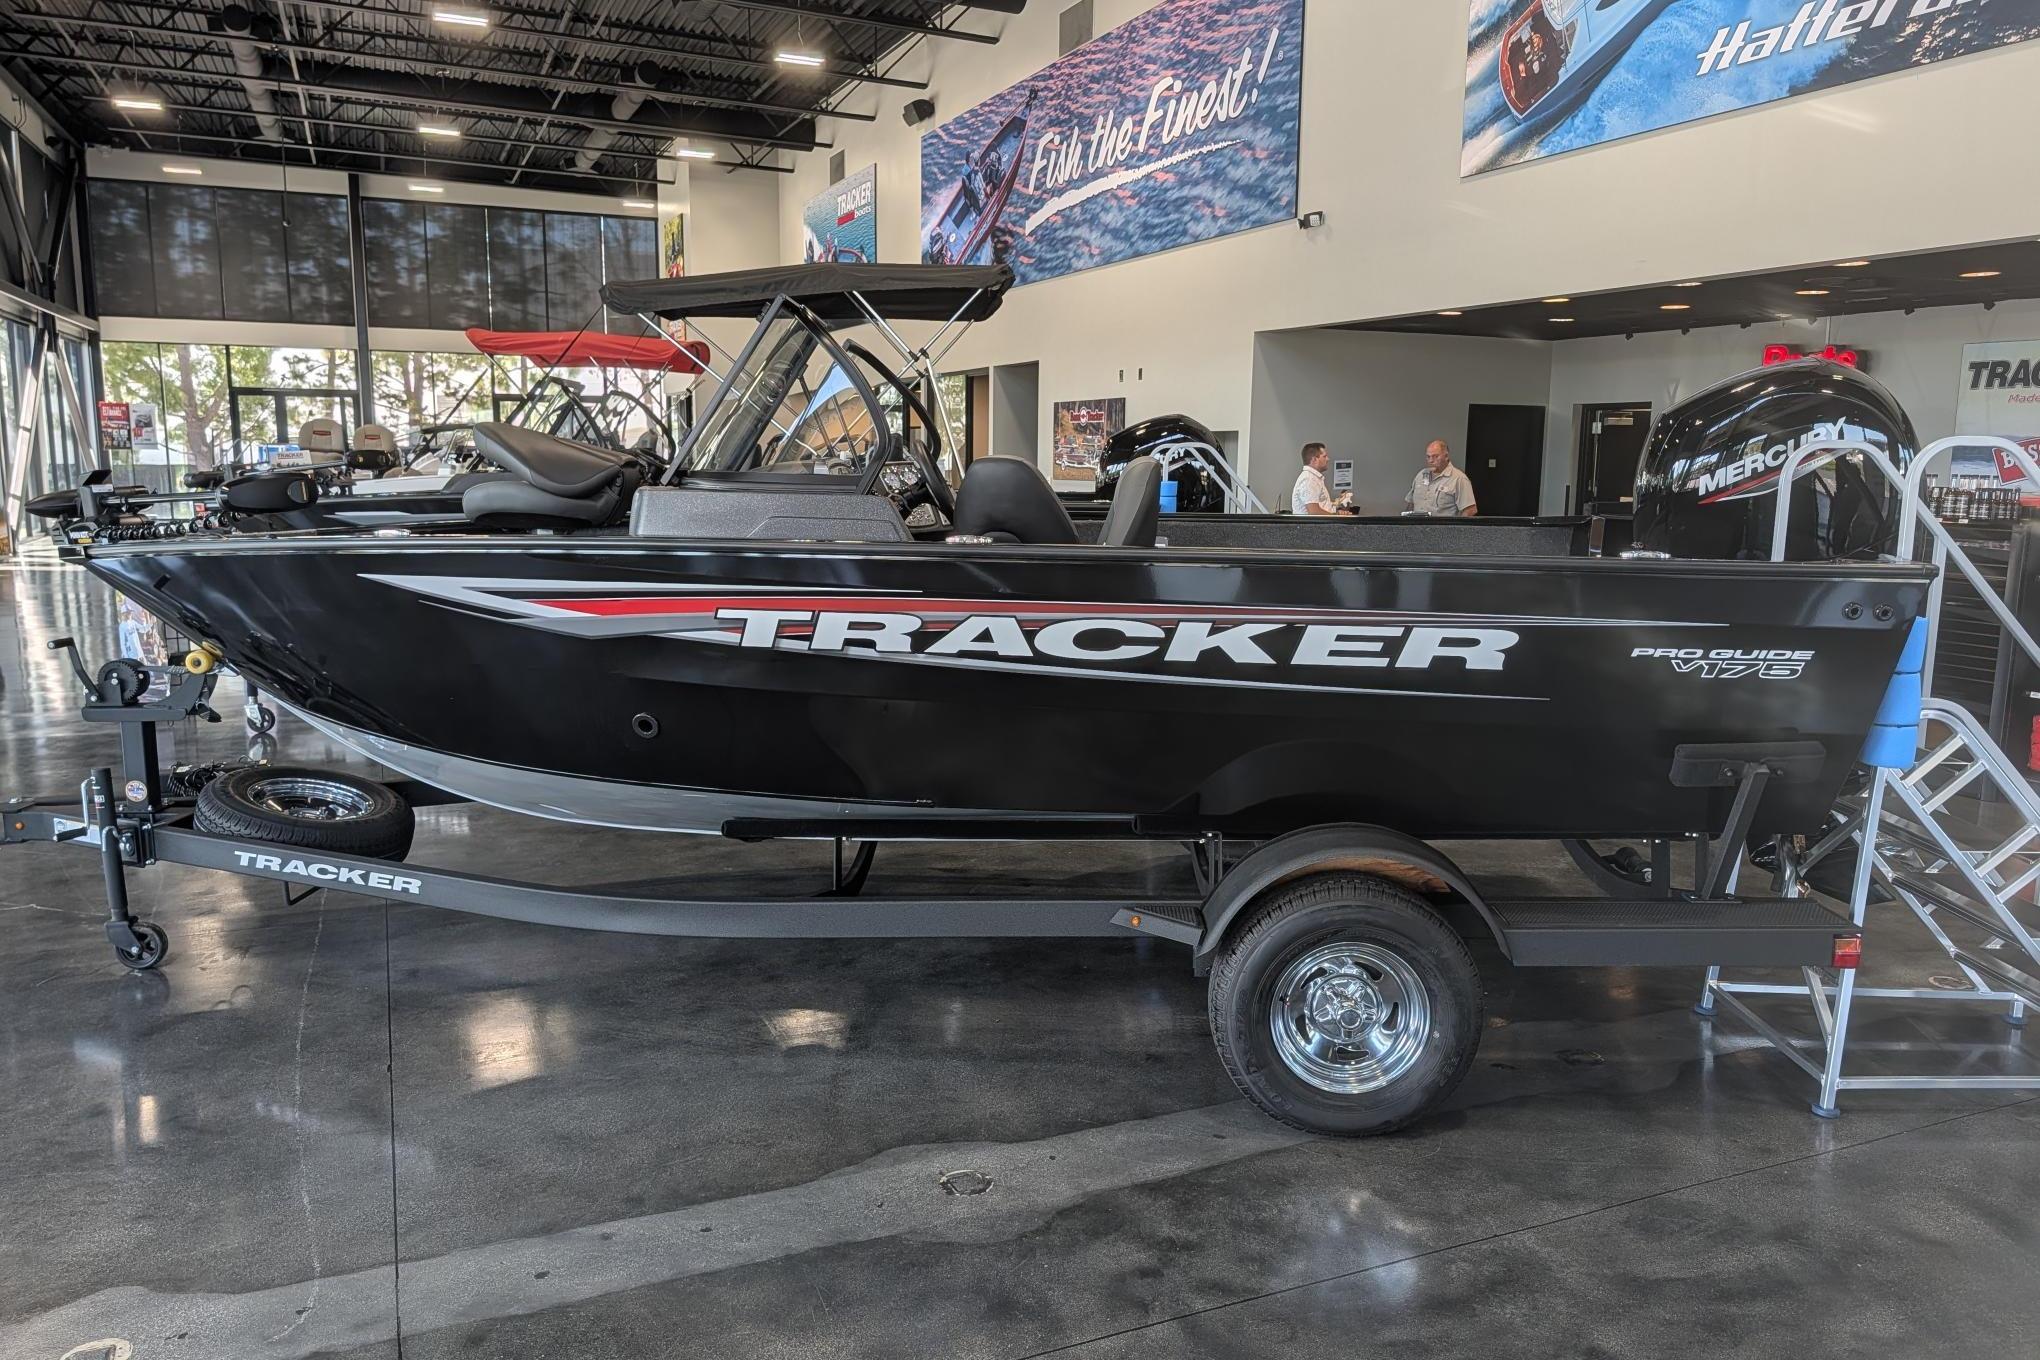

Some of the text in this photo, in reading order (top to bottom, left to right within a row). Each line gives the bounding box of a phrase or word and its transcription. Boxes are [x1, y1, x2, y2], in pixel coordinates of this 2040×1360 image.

[1696, 0, 1989, 76] Hatter
[1028, 28, 1280, 196] Fish the Finest!
[837, 181, 871, 217] TRACKER
[715, 608, 1520, 671] TRACKER
[1631, 647, 1816, 660] PRO GUIDE
[1671, 659, 1806, 680] V175
[234, 850, 422, 894] TRACKER
